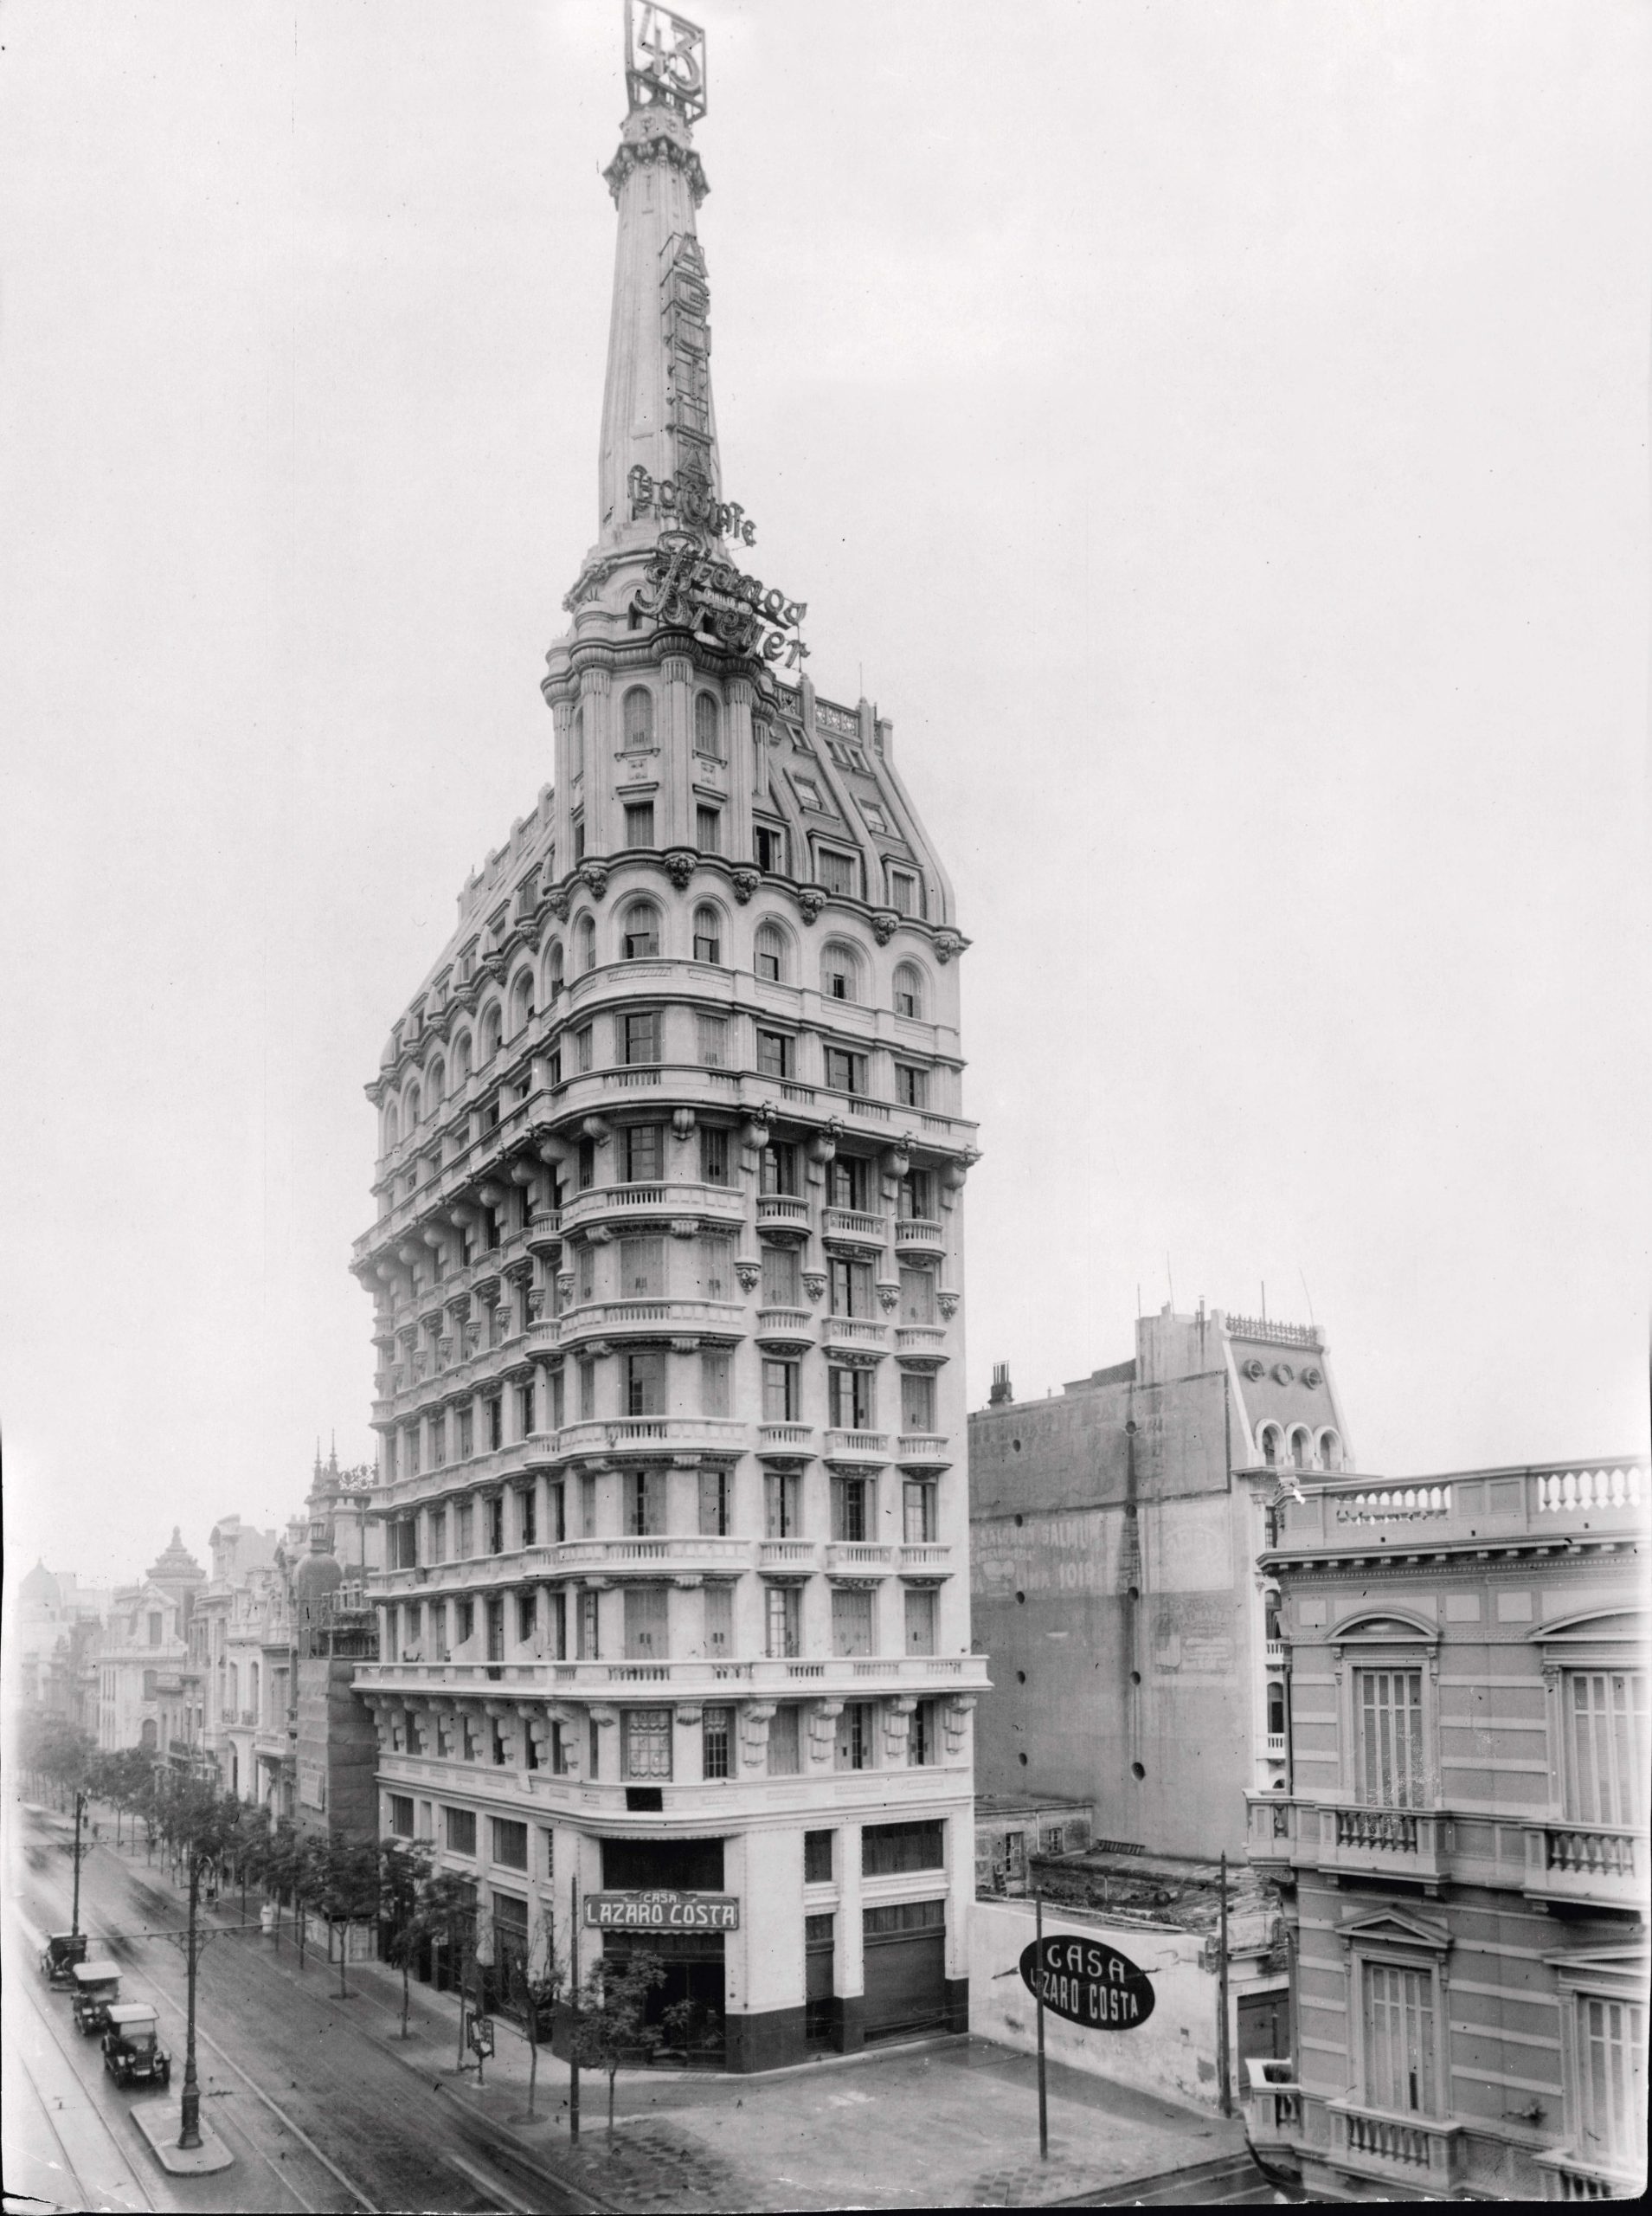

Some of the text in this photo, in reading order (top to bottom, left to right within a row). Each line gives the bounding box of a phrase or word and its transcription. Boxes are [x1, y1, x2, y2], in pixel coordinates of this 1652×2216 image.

[637, 3, 703, 92] 43
[588, 1904, 736, 1925] LAZARO COSTA
[643, 1893, 677, 1904] CASA
[1047, 1944, 1125, 1983] CASA
[1031, 1968, 1139, 2021] LZARO COSTA
